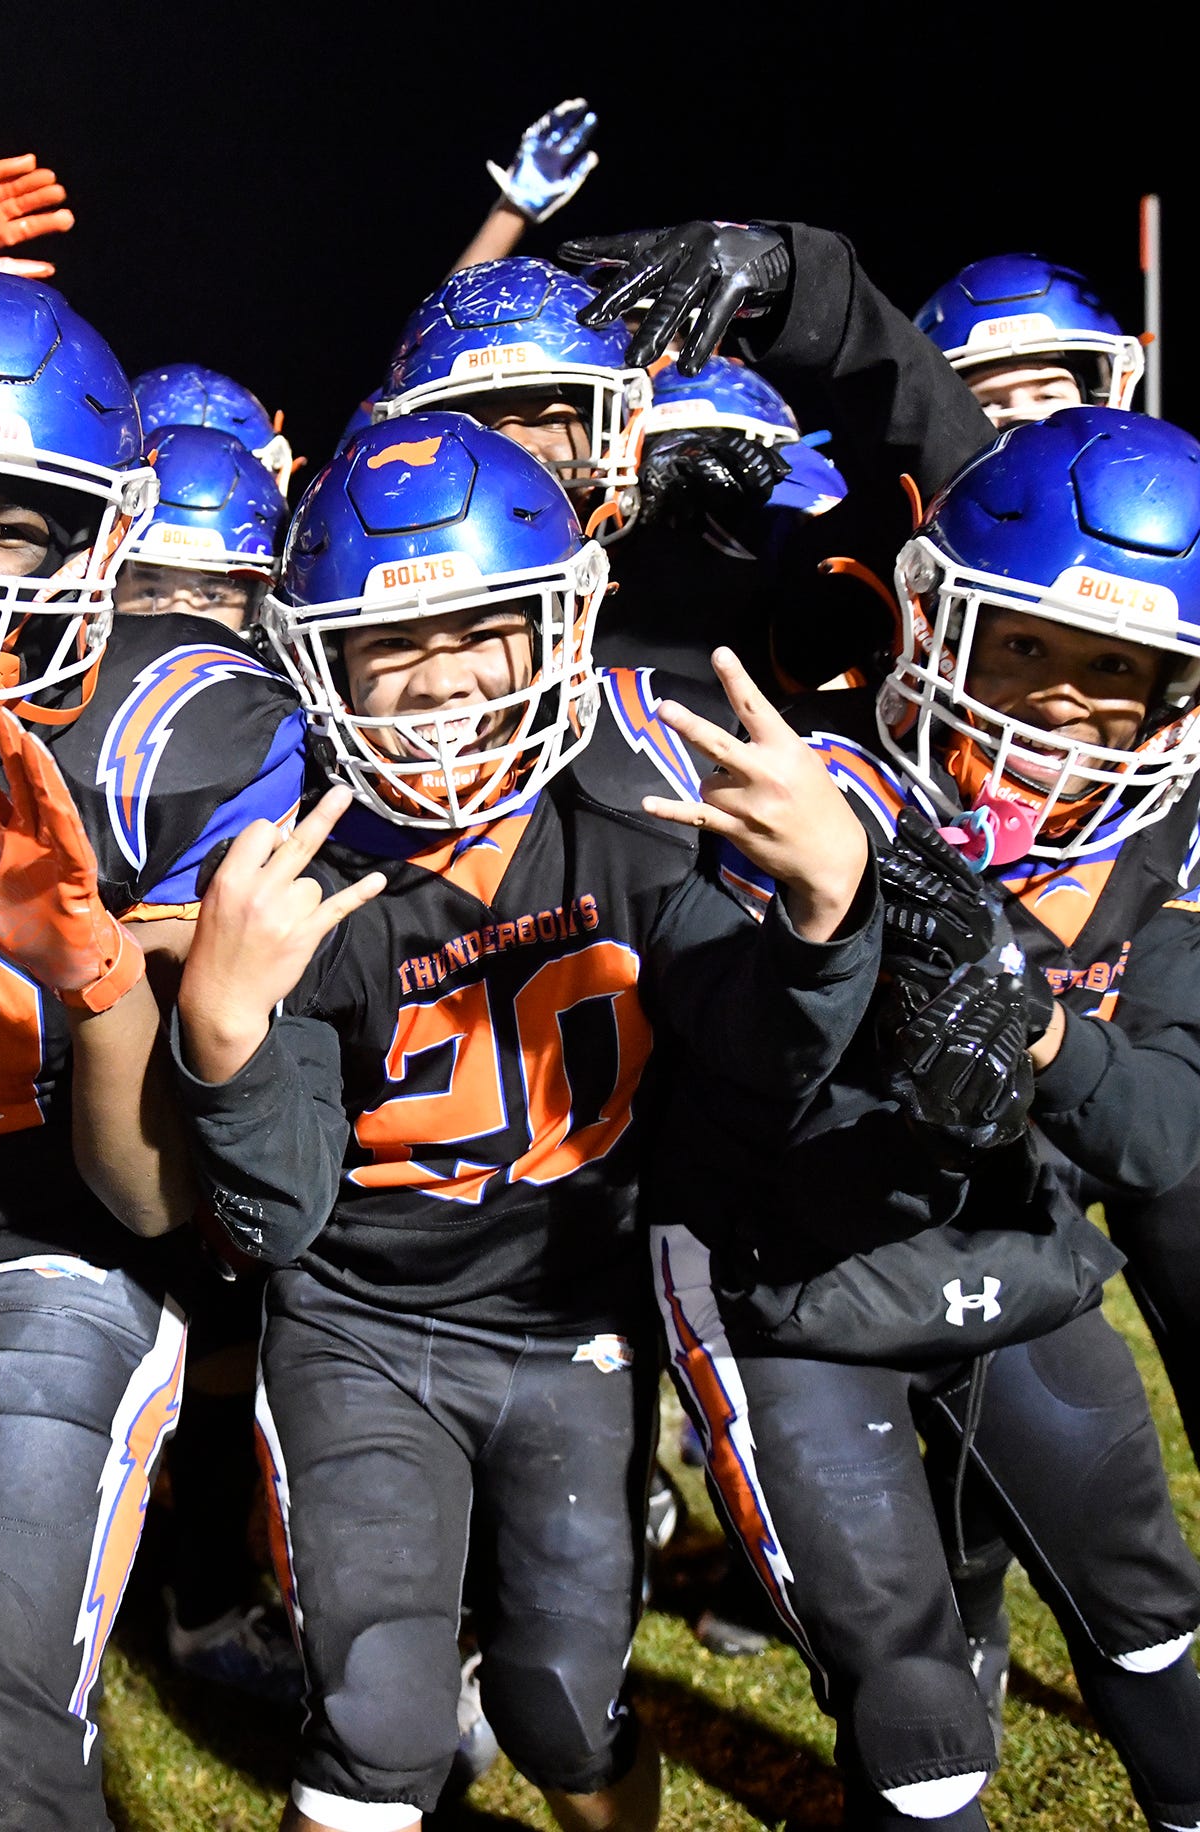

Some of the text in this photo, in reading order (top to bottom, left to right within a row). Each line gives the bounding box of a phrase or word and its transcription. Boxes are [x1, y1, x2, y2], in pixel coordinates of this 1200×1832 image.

[988, 319, 1040, 336] BOLT
[468, 347, 527, 368] BOLTS
[382, 559, 455, 589] BOLTS
[1077, 575, 1157, 613] BOLTS
[421, 769, 480, 788] Ridell
[346, 937, 653, 1205] 20
